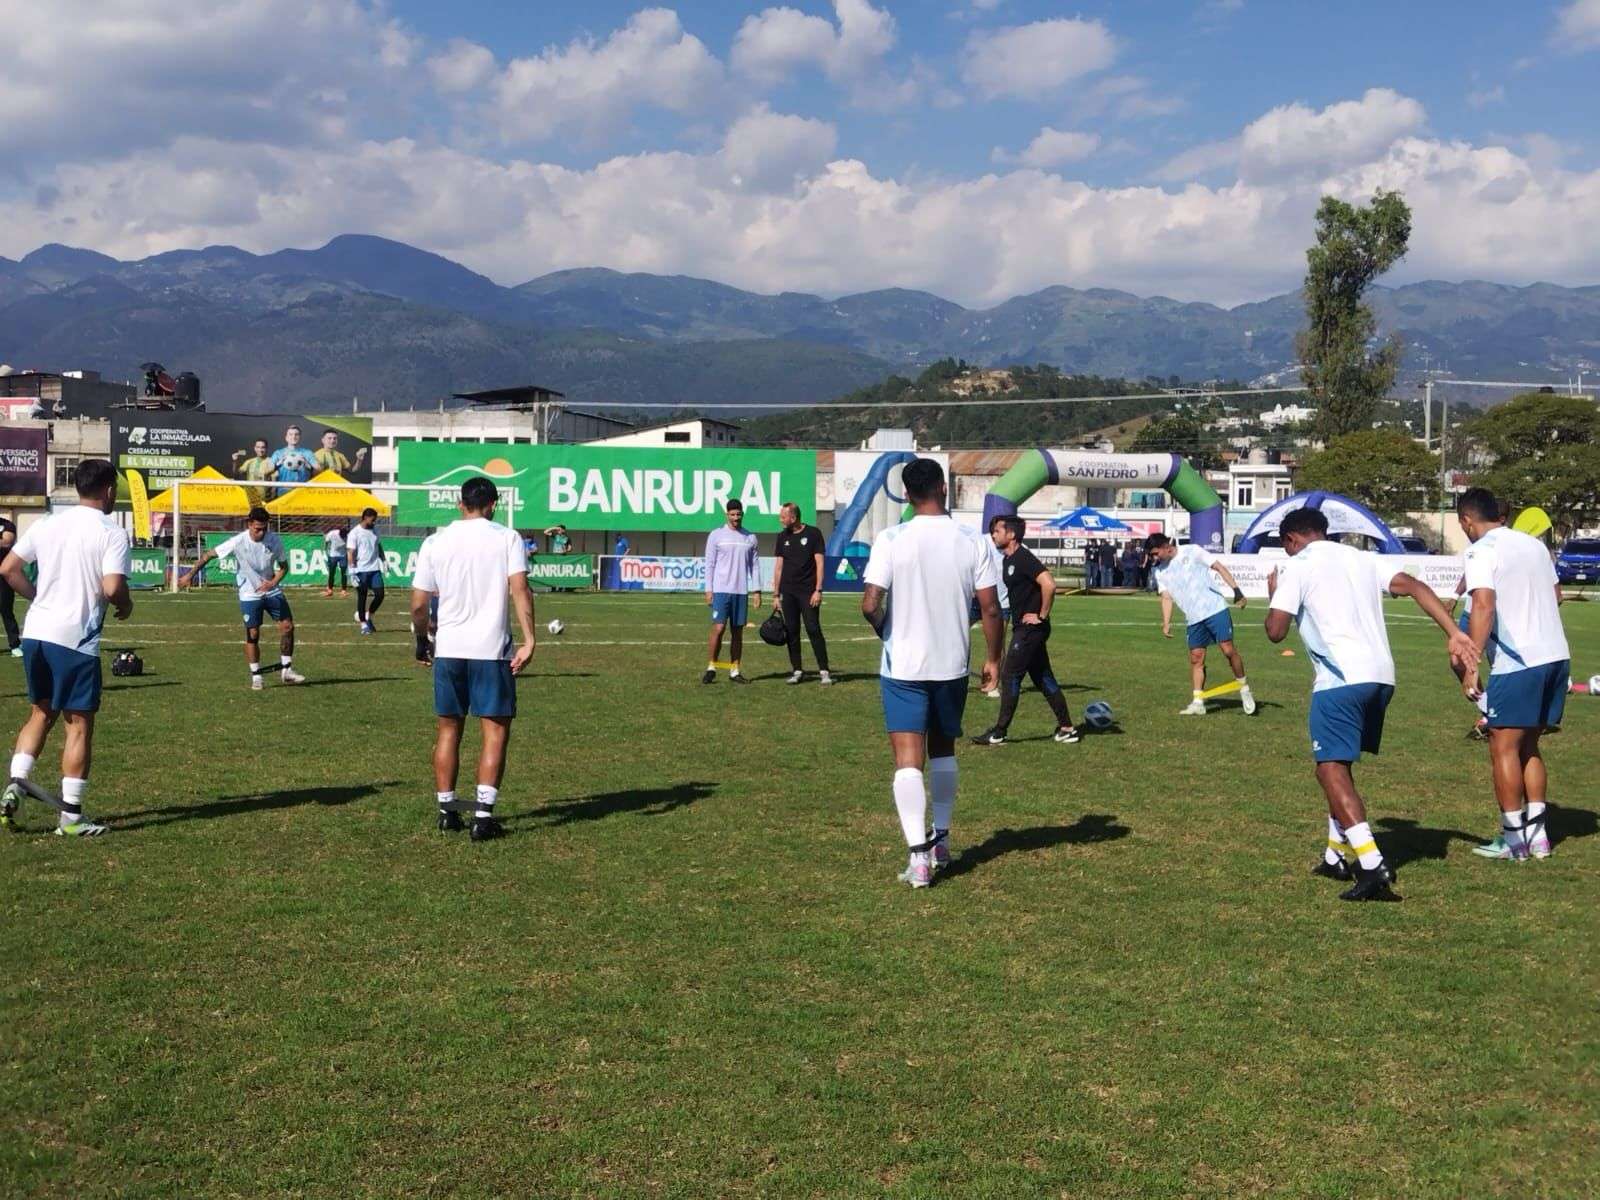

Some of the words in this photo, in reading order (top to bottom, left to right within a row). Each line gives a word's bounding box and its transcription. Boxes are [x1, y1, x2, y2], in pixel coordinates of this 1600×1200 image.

[161, 434, 211, 442] INMACULADA
[7, 457, 38, 466] VINCI
[127, 457, 138, 466] EL
[141, 458, 188, 468] TALENTO
[1067, 462, 1095, 477] SAN
[1097, 468, 1139, 479] PEDRO
[549, 467, 783, 515] BANRURAL
